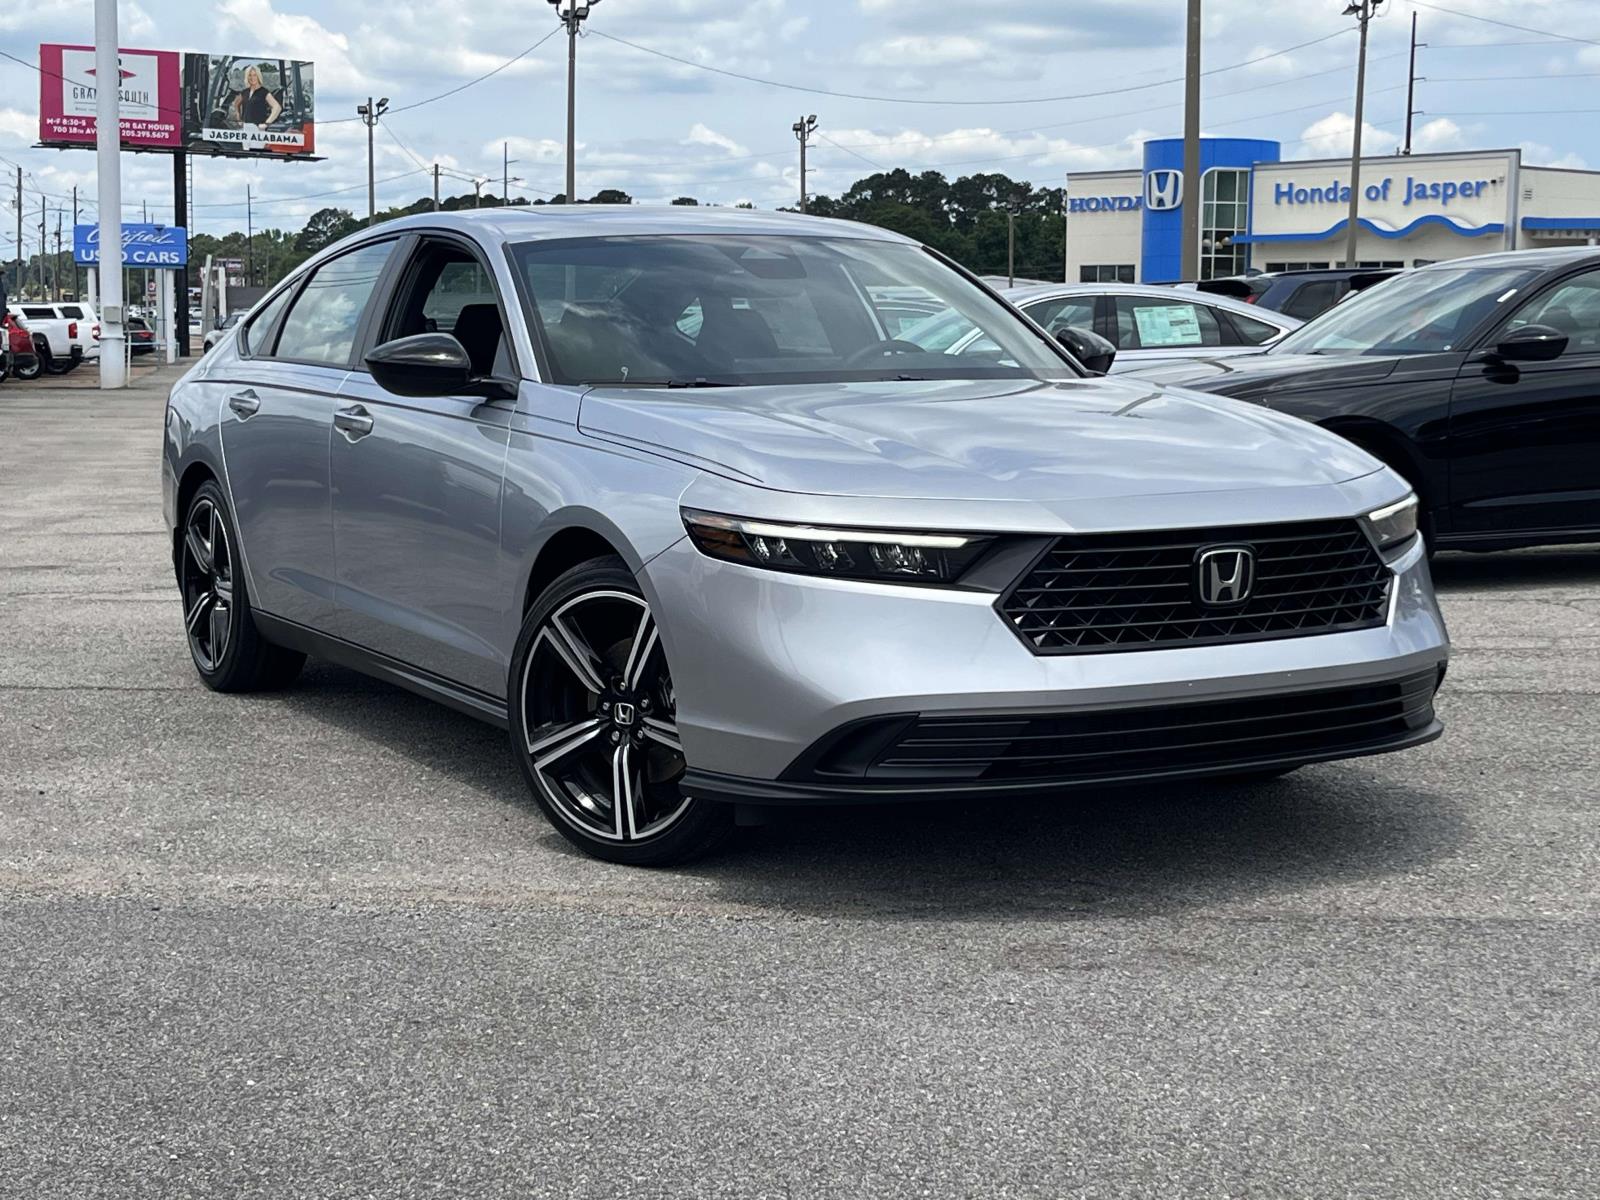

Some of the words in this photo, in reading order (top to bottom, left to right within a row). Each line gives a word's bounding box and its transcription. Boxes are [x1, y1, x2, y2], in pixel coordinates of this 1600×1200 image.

[73, 87, 96, 99] GRA
[118, 89, 149, 103] SOUTH
[132, 122, 146, 130] SAT
[147, 123, 175, 131] HOURS
[209, 131, 248, 141] JASPER
[250, 133, 298, 143] ALABAMA
[1274, 180, 1351, 205] Honda
[1365, 178, 1392, 201] of
[1403, 177, 1488, 206] Jasper
[133, 251, 180, 263] CARS
